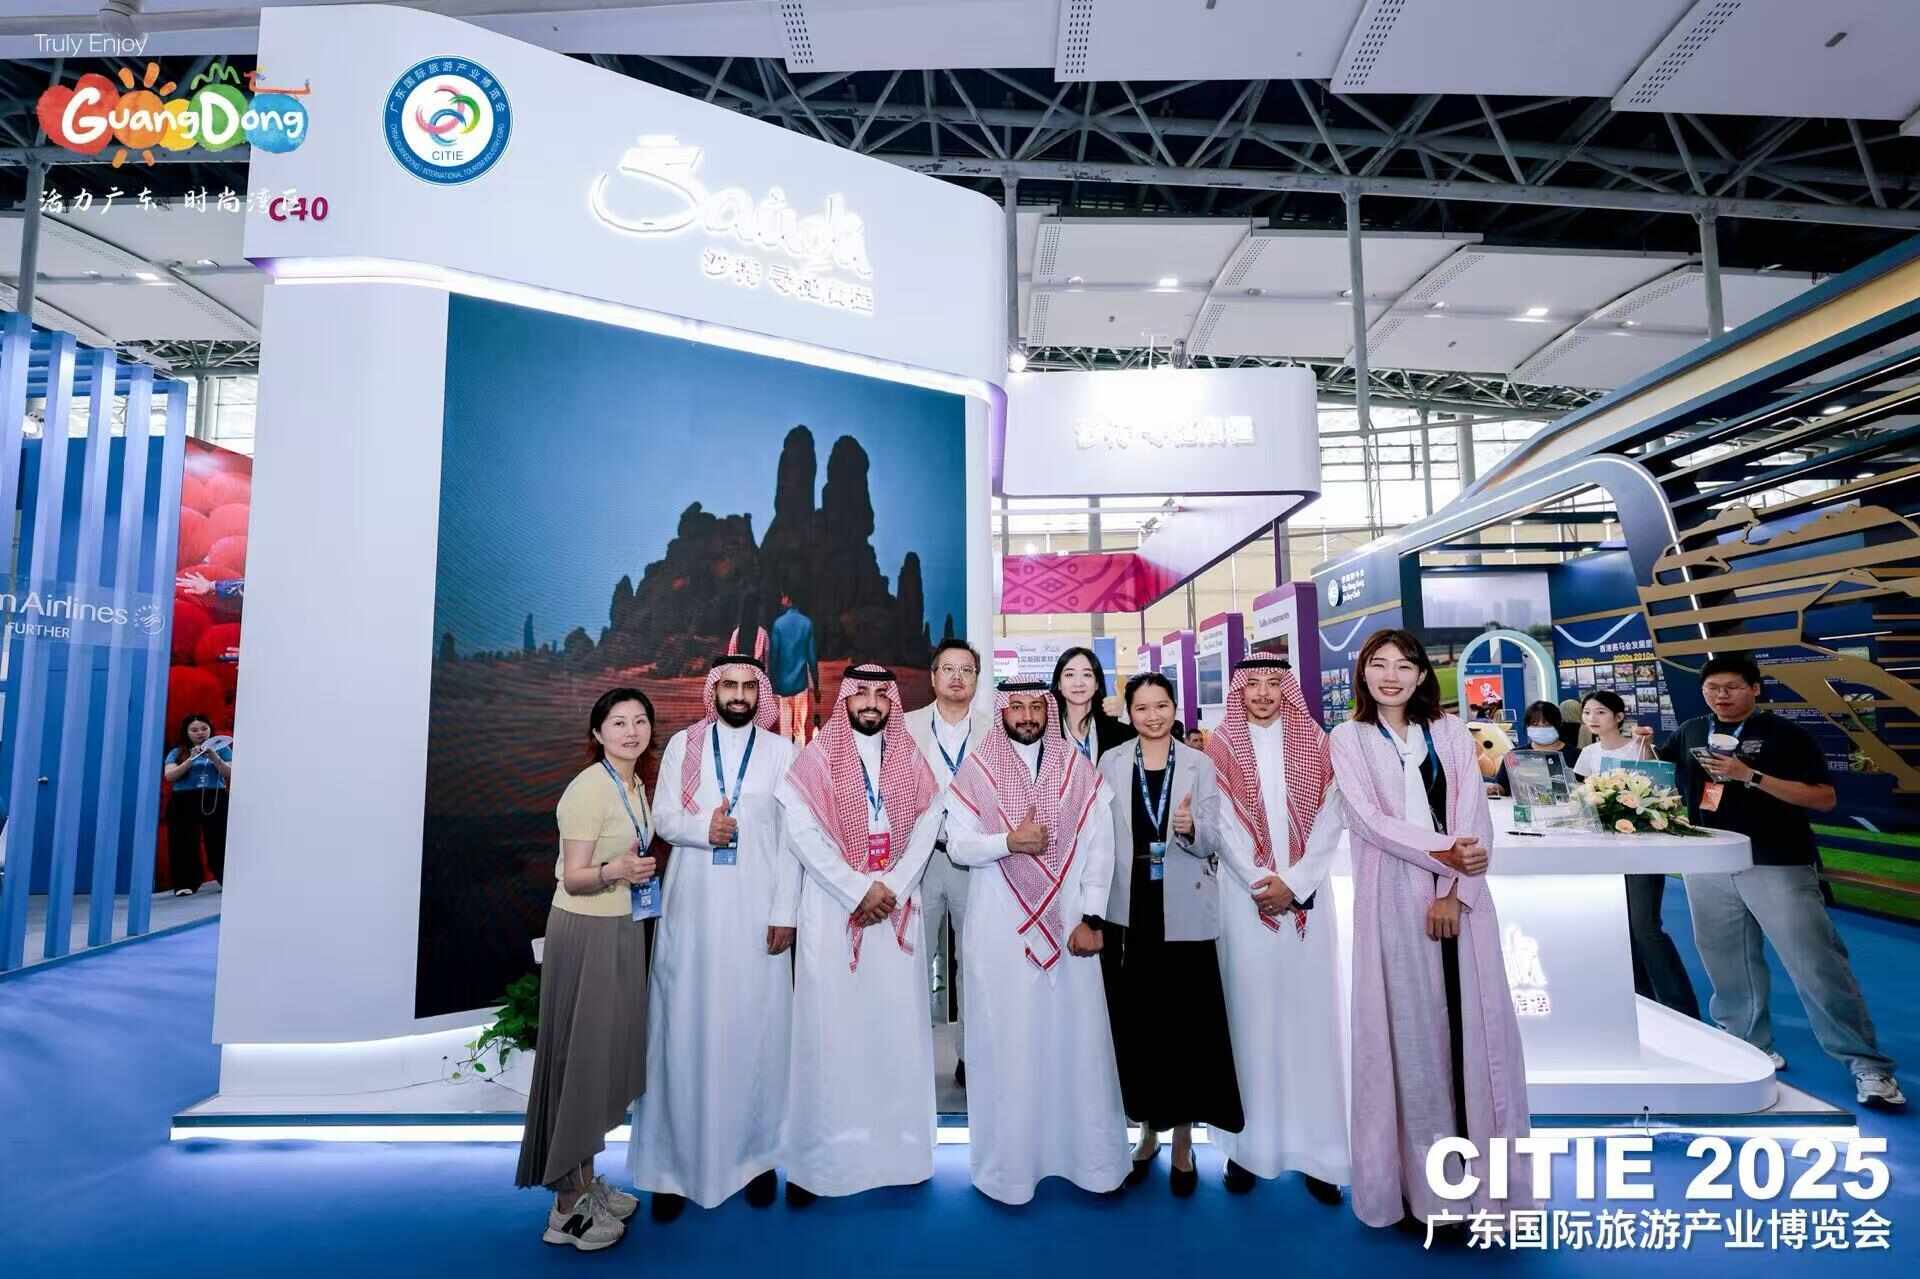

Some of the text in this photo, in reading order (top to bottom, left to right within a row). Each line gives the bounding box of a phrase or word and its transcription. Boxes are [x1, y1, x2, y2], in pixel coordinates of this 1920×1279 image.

[431, 149, 465, 161] CITIE
[269, 196, 329, 221] C40
[20, 591, 128, 625] Airlines
[8, 622, 70, 639] FURTHER
